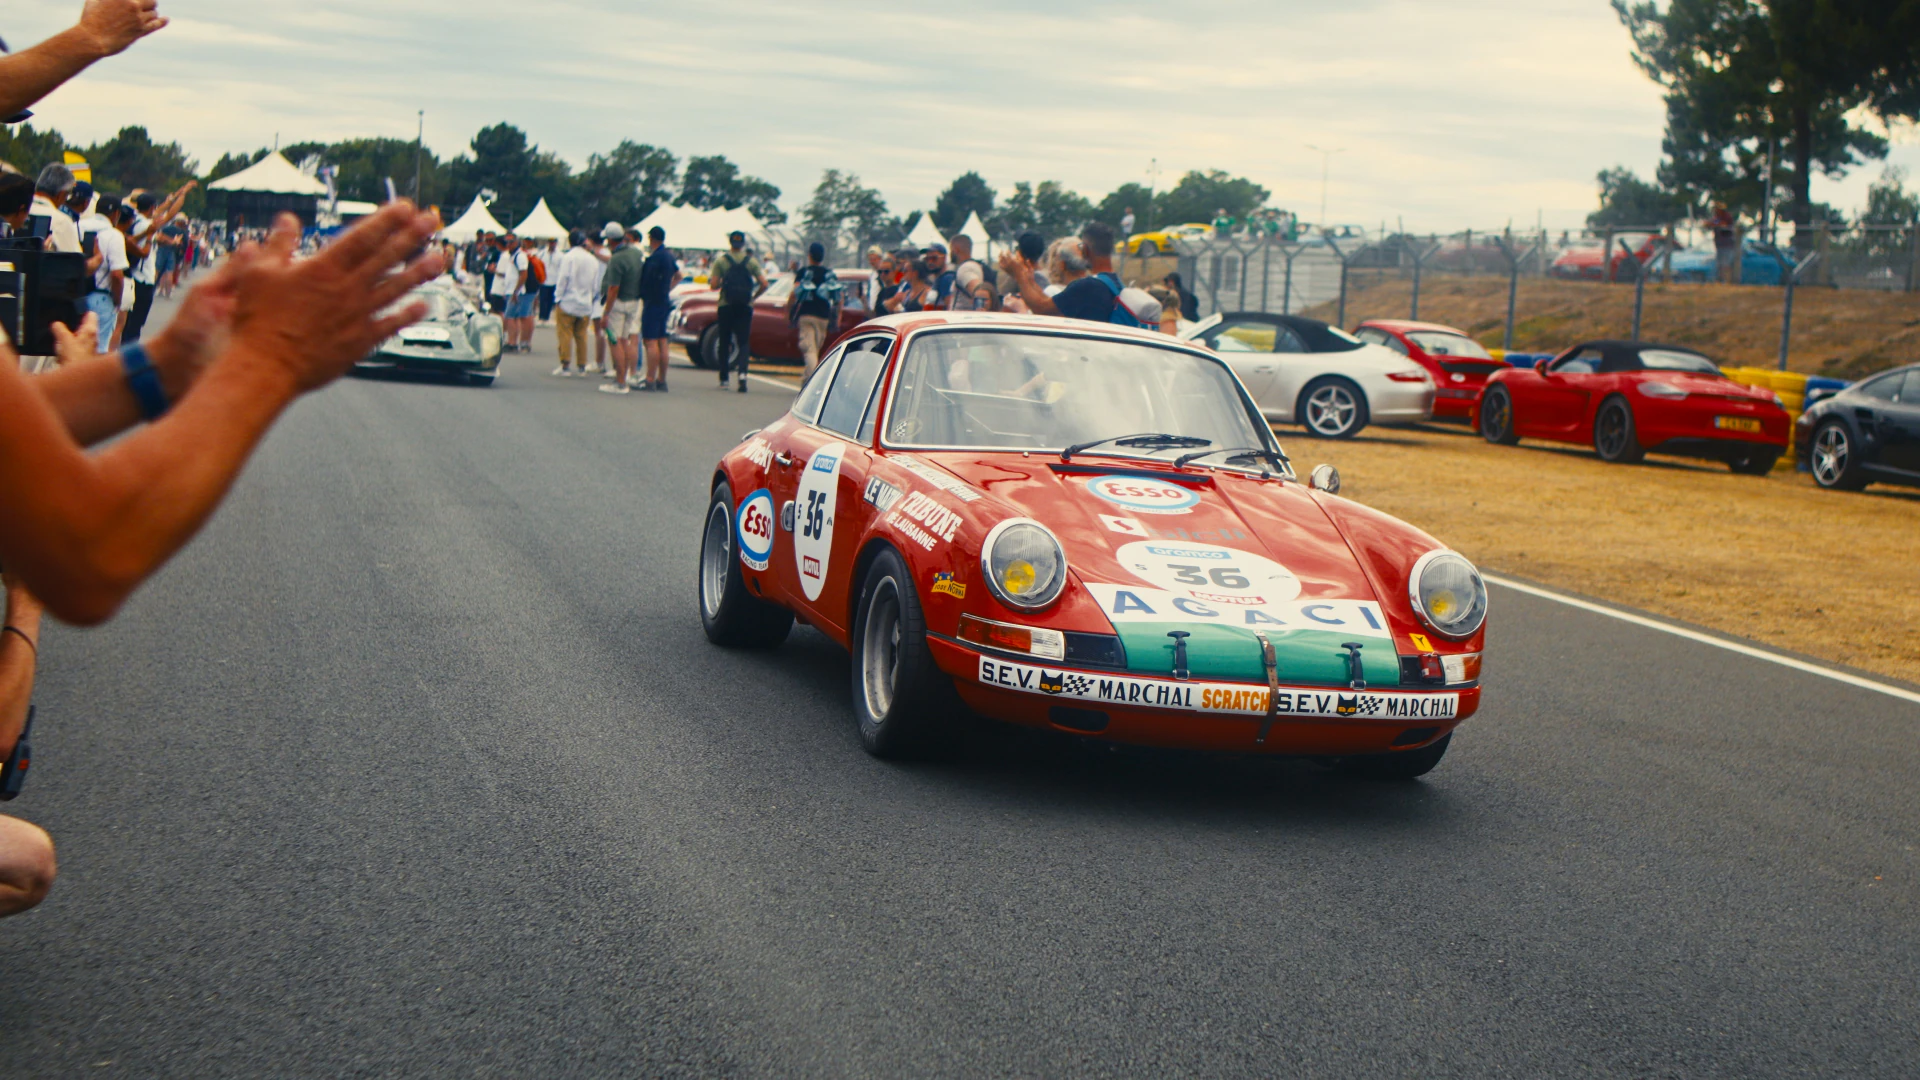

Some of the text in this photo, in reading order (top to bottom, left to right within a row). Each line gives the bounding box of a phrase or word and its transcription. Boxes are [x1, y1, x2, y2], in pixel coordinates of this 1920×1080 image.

[864, 477, 881, 502] LE
[744, 504, 772, 540] Esso
[803, 489, 827, 541] 36
[898, 490, 964, 543] TRIBUNE
[895, 515, 938, 551] LAUSANNE
[1153, 546, 1225, 559] aramco
[804, 557, 820, 577] MOTUL
[1166, 563, 1251, 589] 36
[1113, 590, 1382, 630] AGACI
[1193, 592, 1266, 605] MOTUL
[982, 661, 1192, 707] S.E.V. MARCHAL
[1201, 688, 1270, 712] SCRATCH
[1277, 693, 1454, 717] S.E.V. MARCHAL
